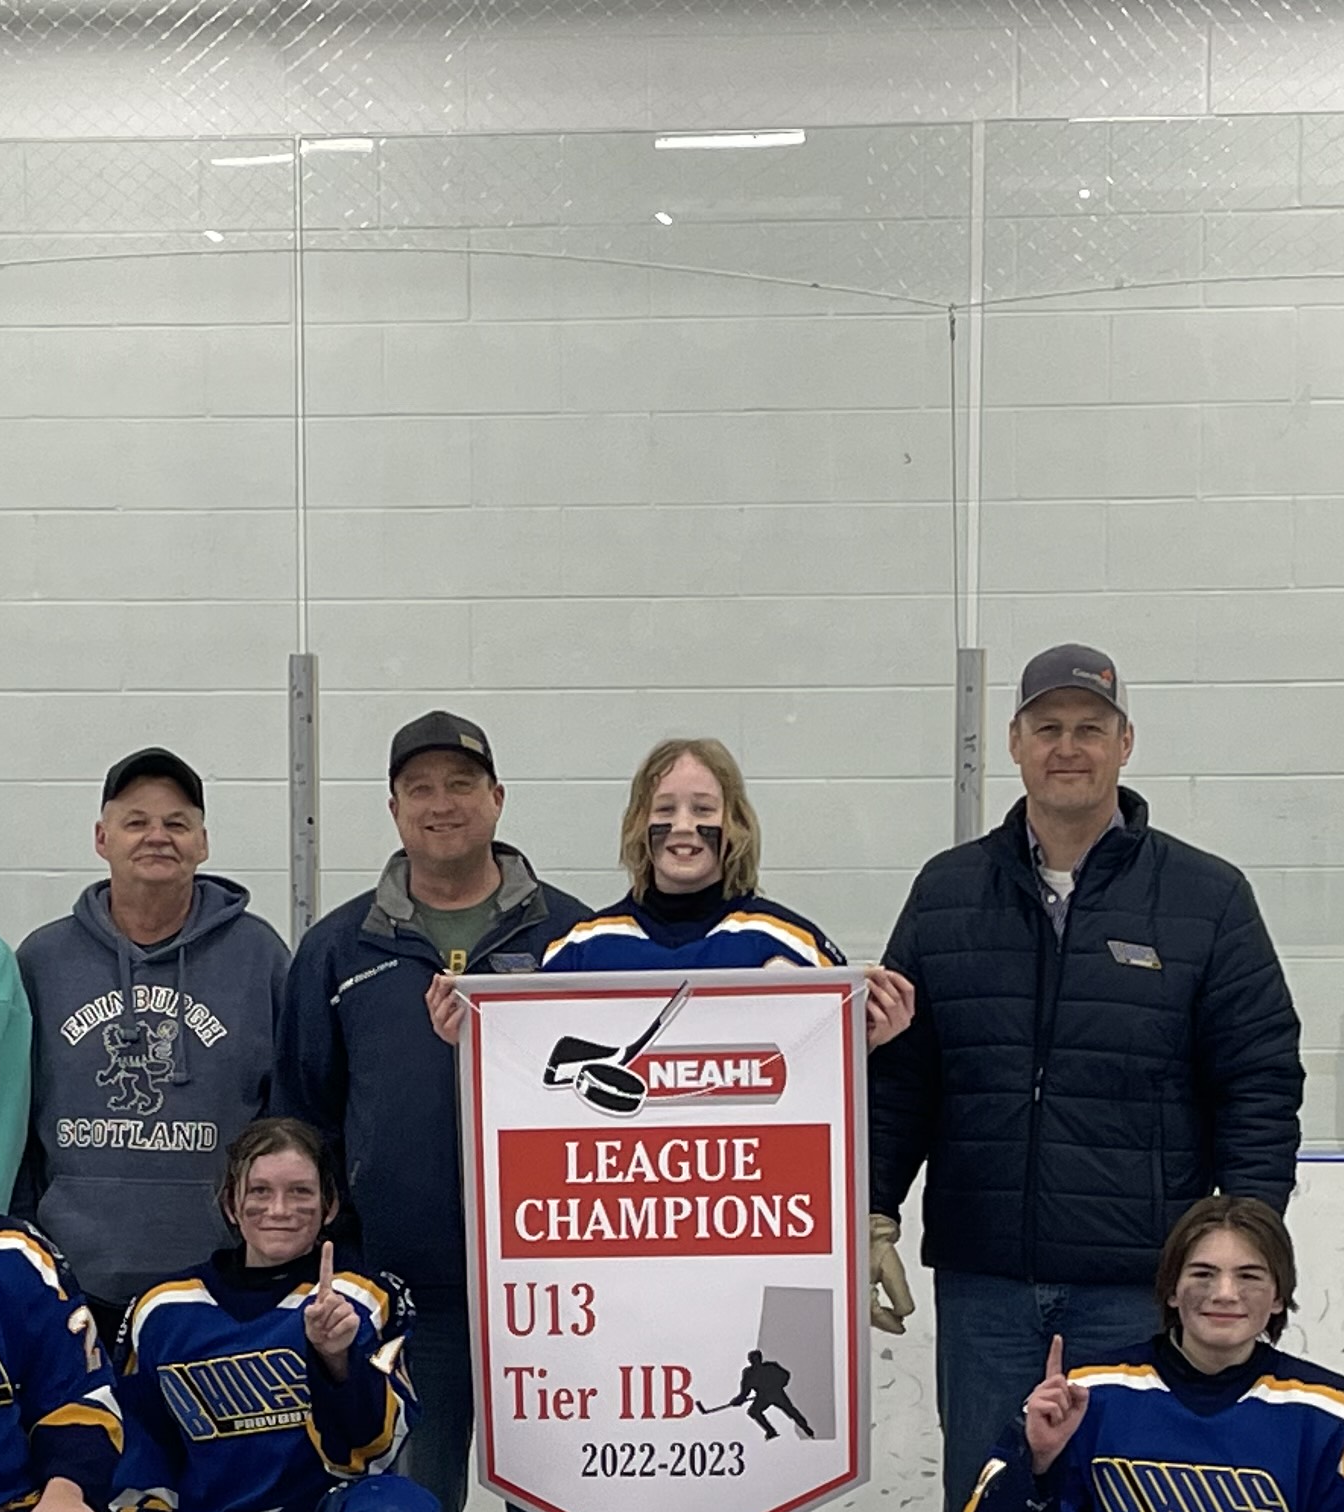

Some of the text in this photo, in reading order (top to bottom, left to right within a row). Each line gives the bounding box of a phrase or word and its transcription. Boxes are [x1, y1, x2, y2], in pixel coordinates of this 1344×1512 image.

[647, 1059, 774, 1090] NEAHL
[57, 1118, 218, 1151] SCOTLAND
[564, 1137, 762, 1185] LEAGUE
[513, 1193, 816, 1243] CHAMPIONS
[503, 1282, 598, 1337] U13
[504, 1365, 696, 1422] Tier IIB
[580, 1442, 746, 1478] 2022-2023
